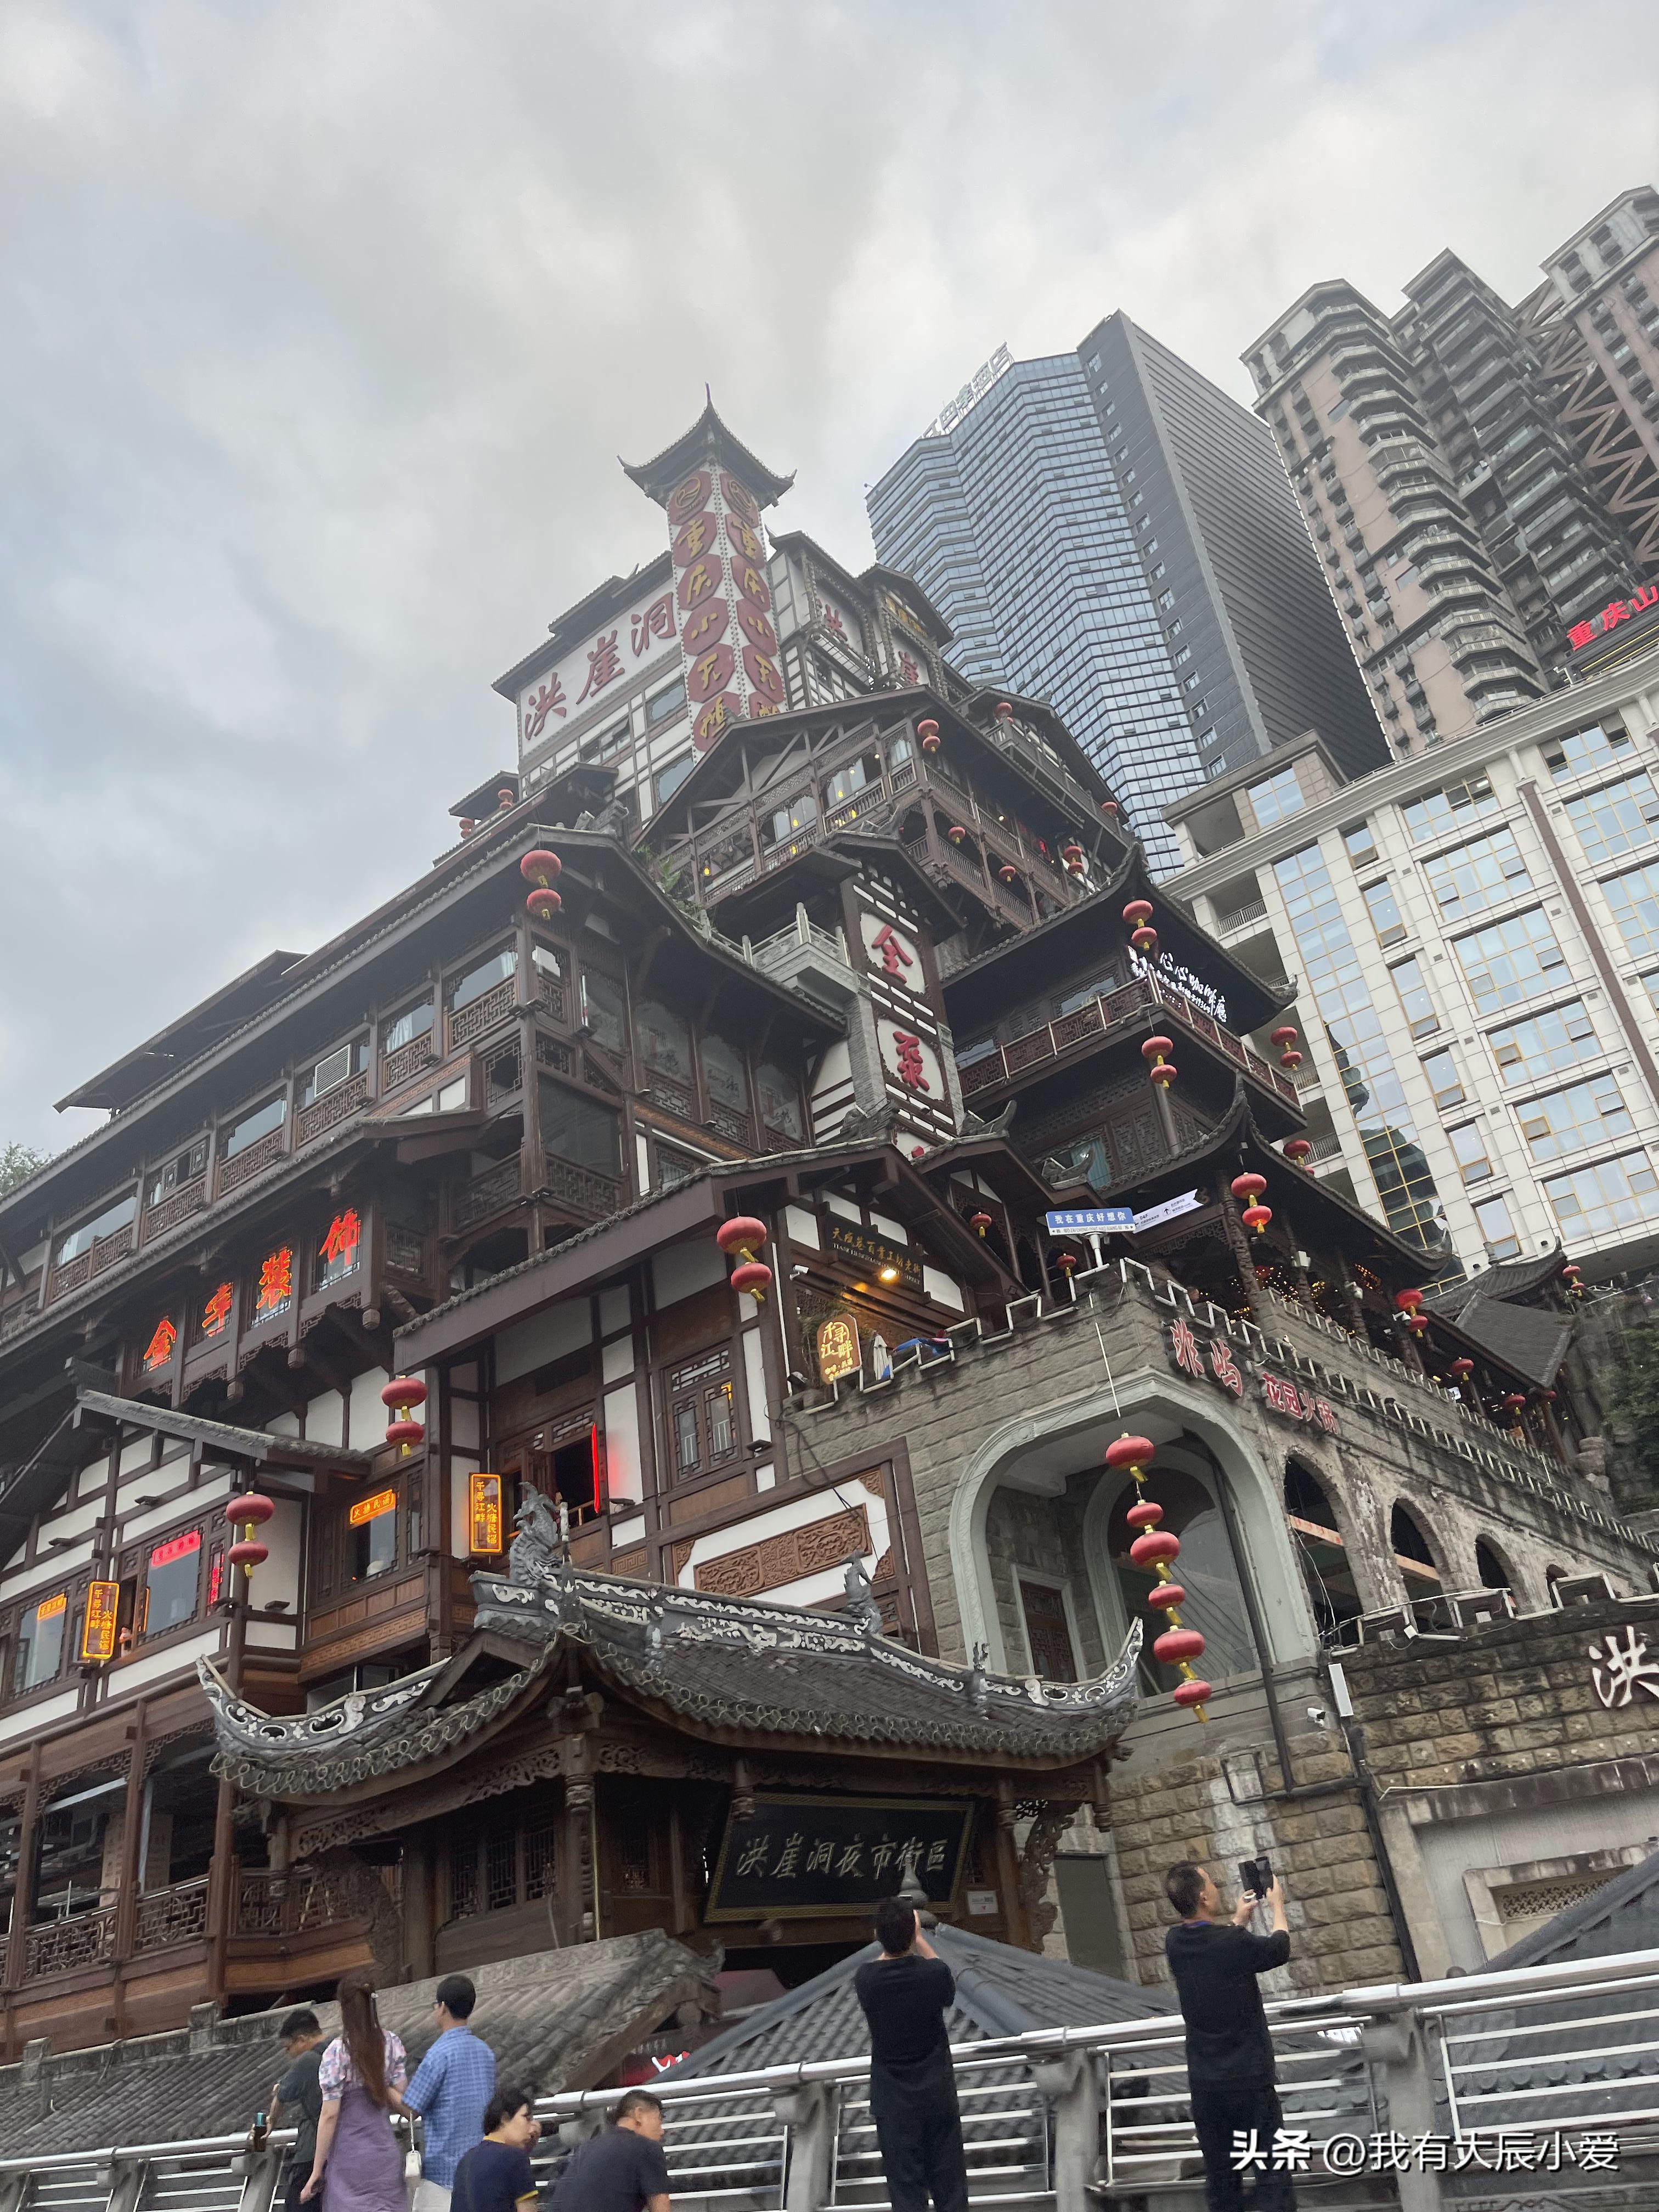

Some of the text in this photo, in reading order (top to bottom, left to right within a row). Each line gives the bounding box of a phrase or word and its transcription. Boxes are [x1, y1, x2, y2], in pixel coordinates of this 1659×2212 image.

[1566, 585, 1658, 651] 重庆山
[524, 591, 676, 740] 洪崖洞
[1054, 1211, 1126, 1224] 我在重庆好想你
[1262, 1371, 1339, 1435] 花园火锅
[475, 1481, 486, 1522] 千寻江畔
[89, 1589, 104, 1629] 千寻江畔
[1588, 1626, 1659, 1708] 洪
[736, 1831, 949, 1879] 洪崖洞夜市街區
